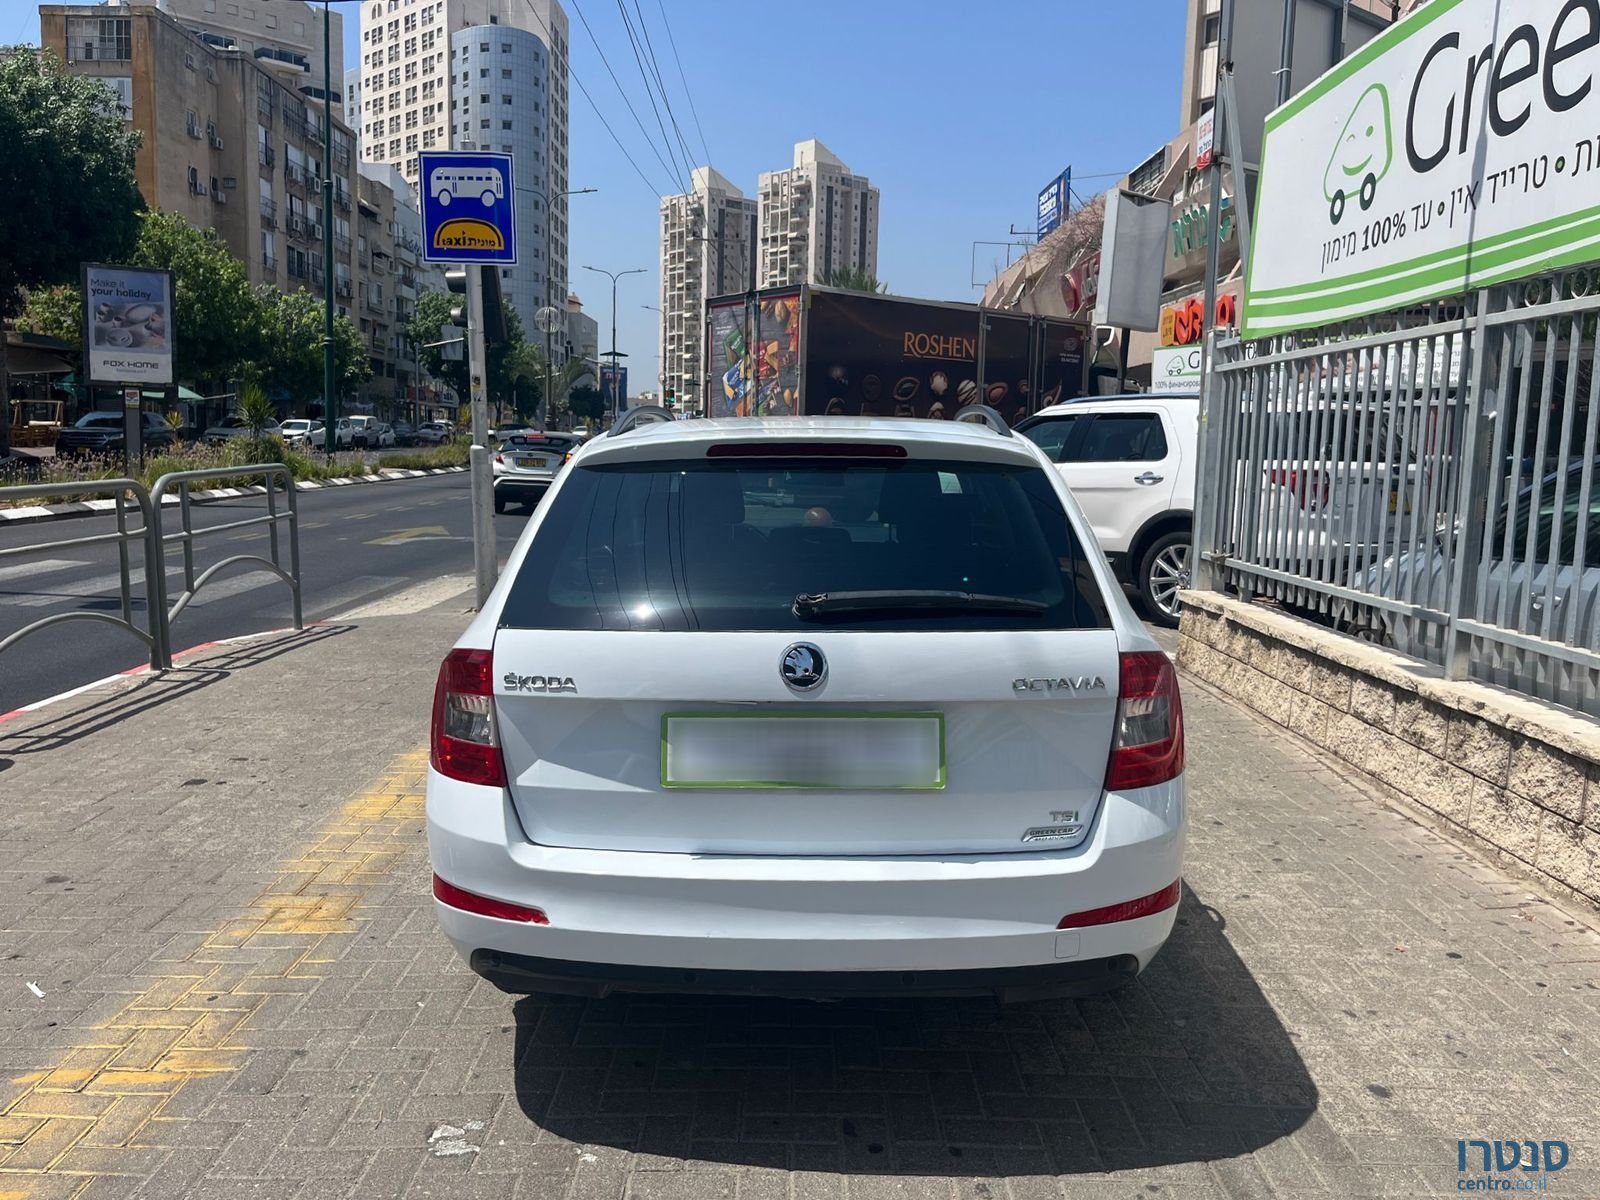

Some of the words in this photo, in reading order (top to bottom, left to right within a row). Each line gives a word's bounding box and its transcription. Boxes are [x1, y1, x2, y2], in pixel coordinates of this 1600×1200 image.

[1405, 0, 1600, 174] Gree
[1486, 154, 1549, 204] טרייד
[1411, 200, 1433, 232] עד
[1449, 180, 1479, 229] אין
[467, 236, 496, 247] מונית
[1361, 210, 1407, 251] 100%
[1321, 231, 1357, 274] מימון
[90, 279, 117, 288] Make
[91, 287, 113, 297] your
[116, 288, 152, 300] holiday
[904, 331, 977, 360] ROSHEN
[127, 361, 159, 369] HOME
[503, 671, 578, 694] ŠKODA
[1012, 676, 1106, 692] OCTAVIA
[1049, 810, 1079, 823] TSI
